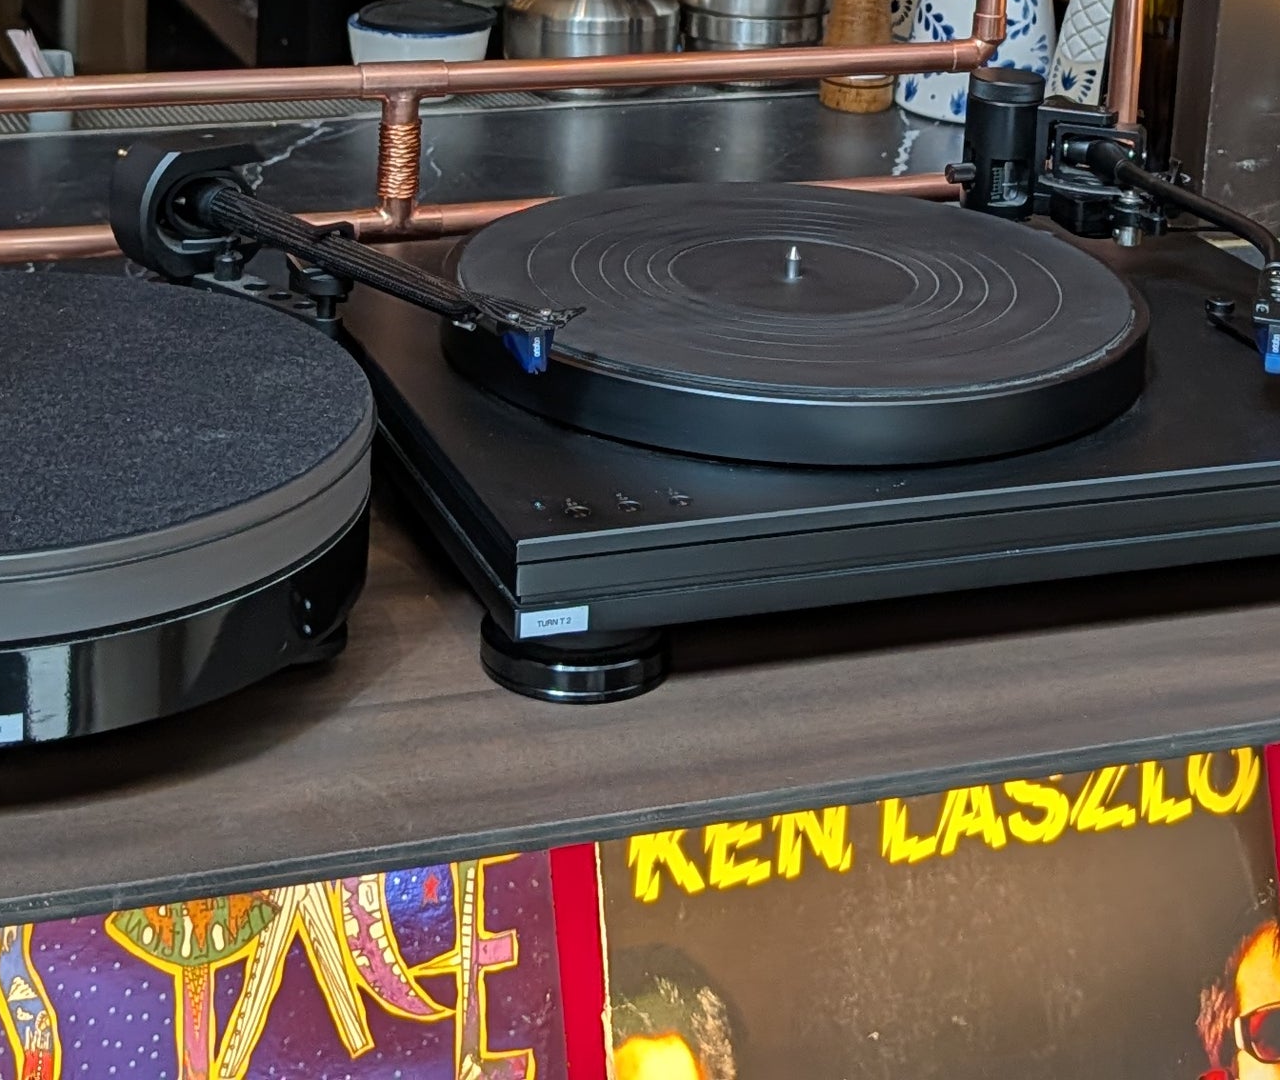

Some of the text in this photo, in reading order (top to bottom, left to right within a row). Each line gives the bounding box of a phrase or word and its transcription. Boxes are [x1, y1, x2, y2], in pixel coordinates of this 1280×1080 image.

[537, 617, 559, 628] TURN
[628, 747, 1263, 902] KEN LASZLO
